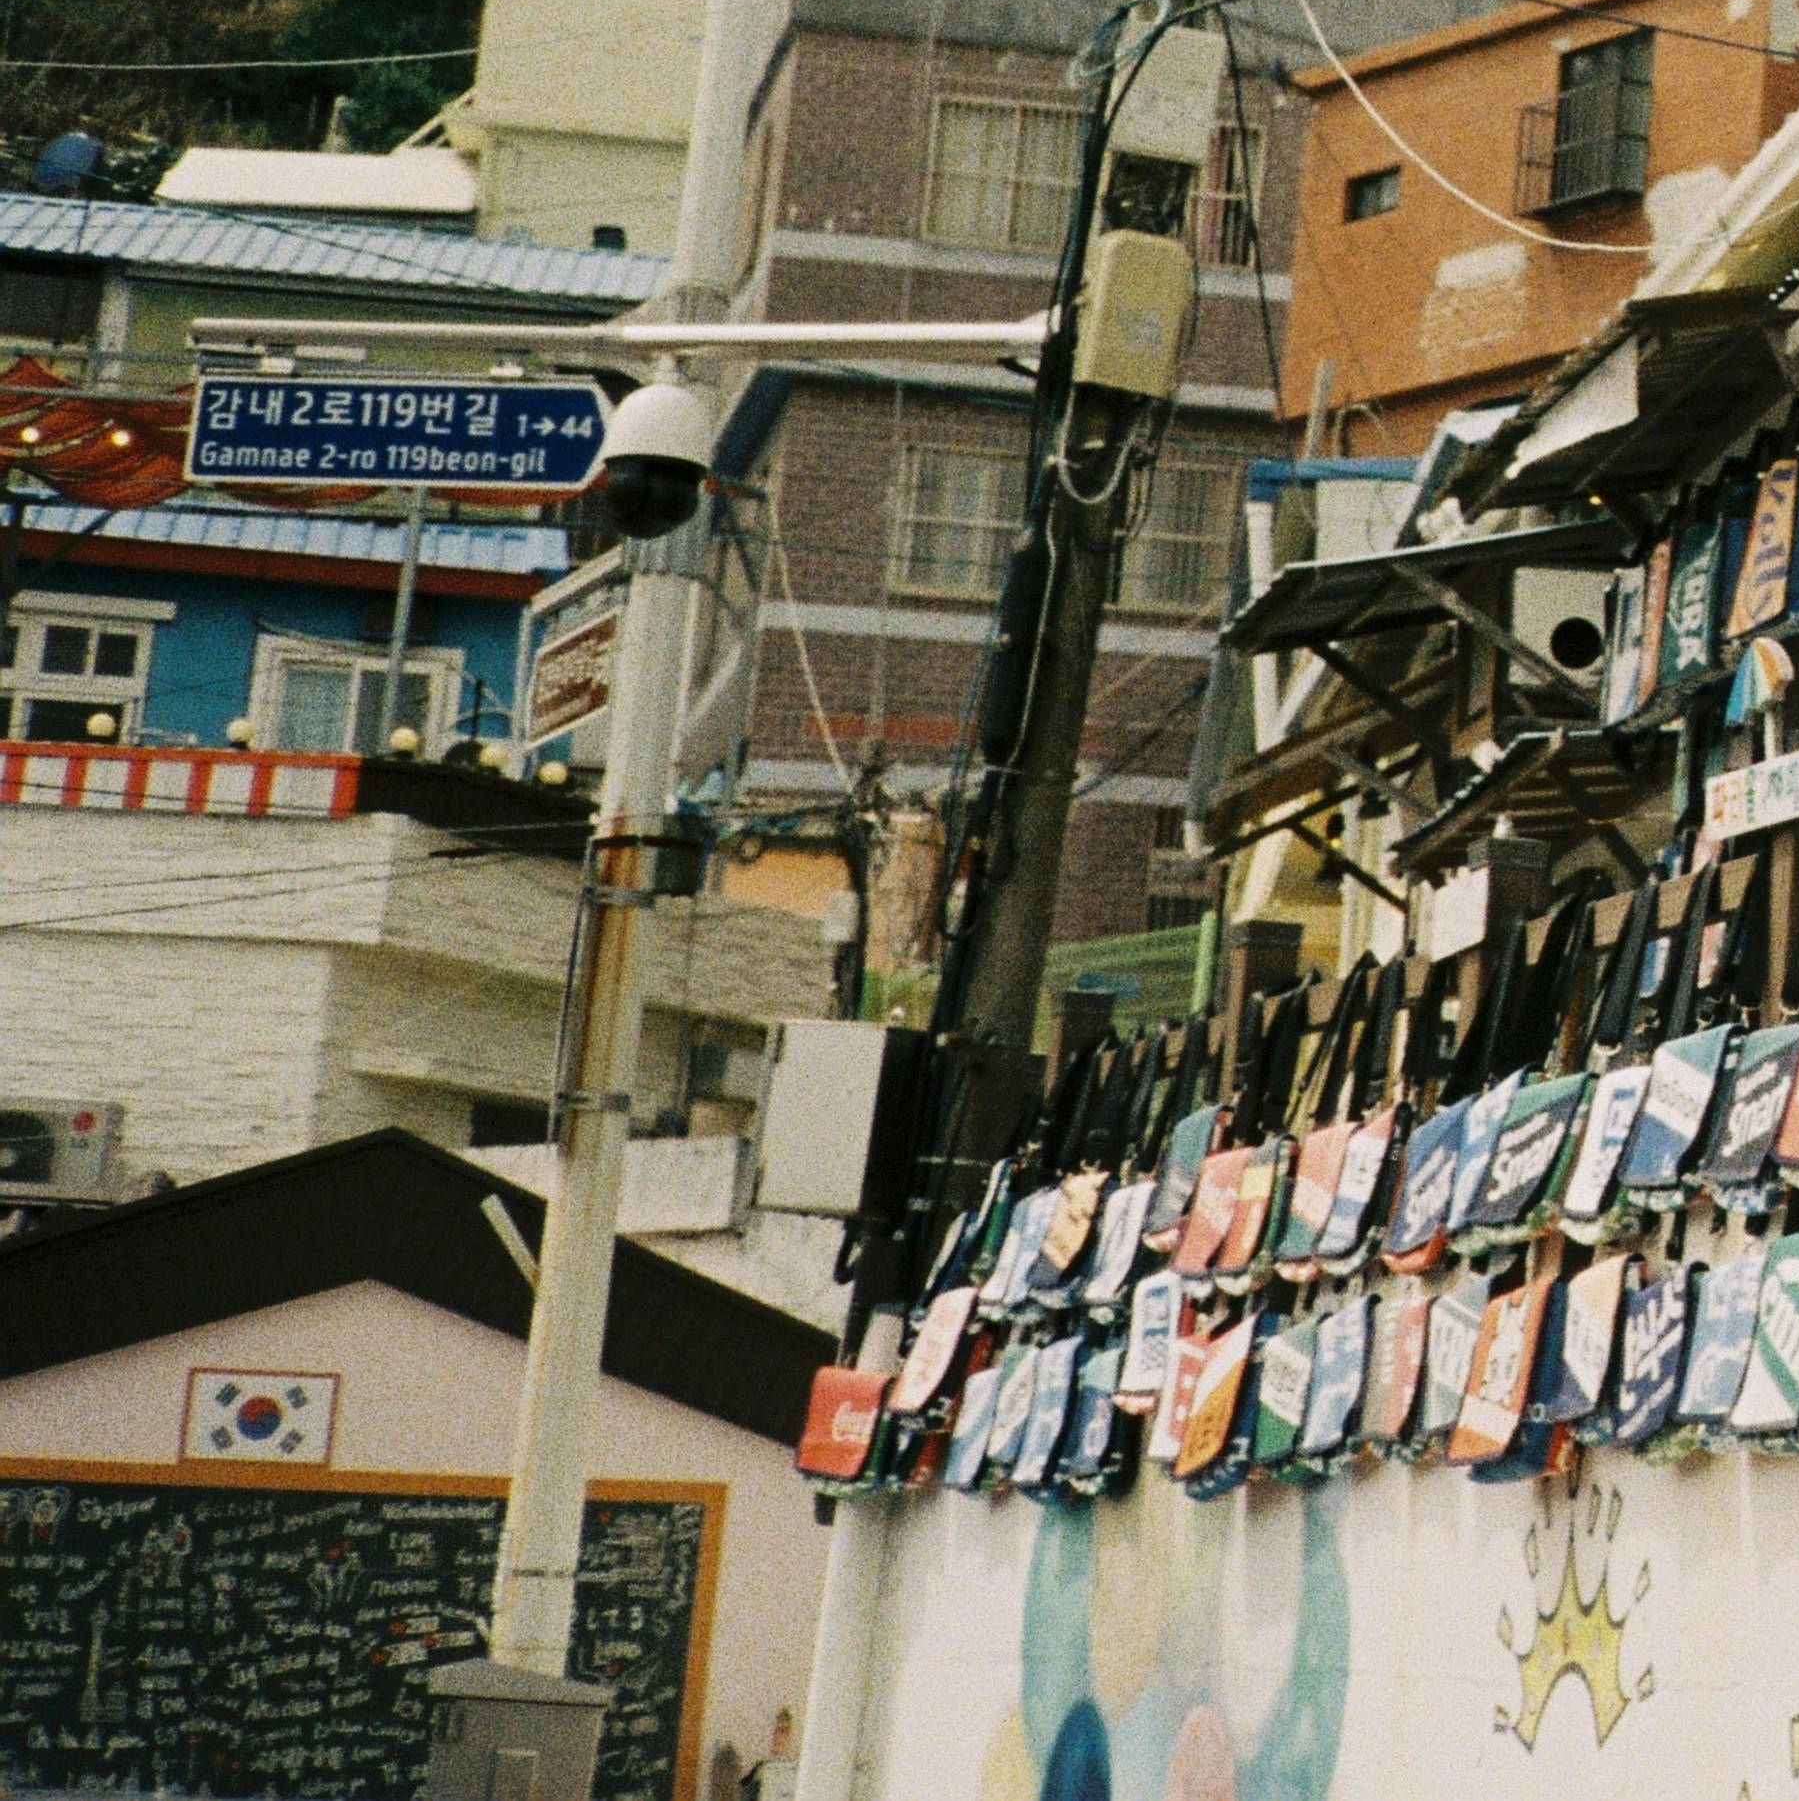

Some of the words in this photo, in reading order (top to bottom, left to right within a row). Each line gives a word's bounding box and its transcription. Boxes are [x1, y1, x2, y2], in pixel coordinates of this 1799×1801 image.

[200, 442, 310, 469] Gamnae
[318, 443, 377, 471] 2-ro
[386, 444, 546, 479] 119beon-gil
